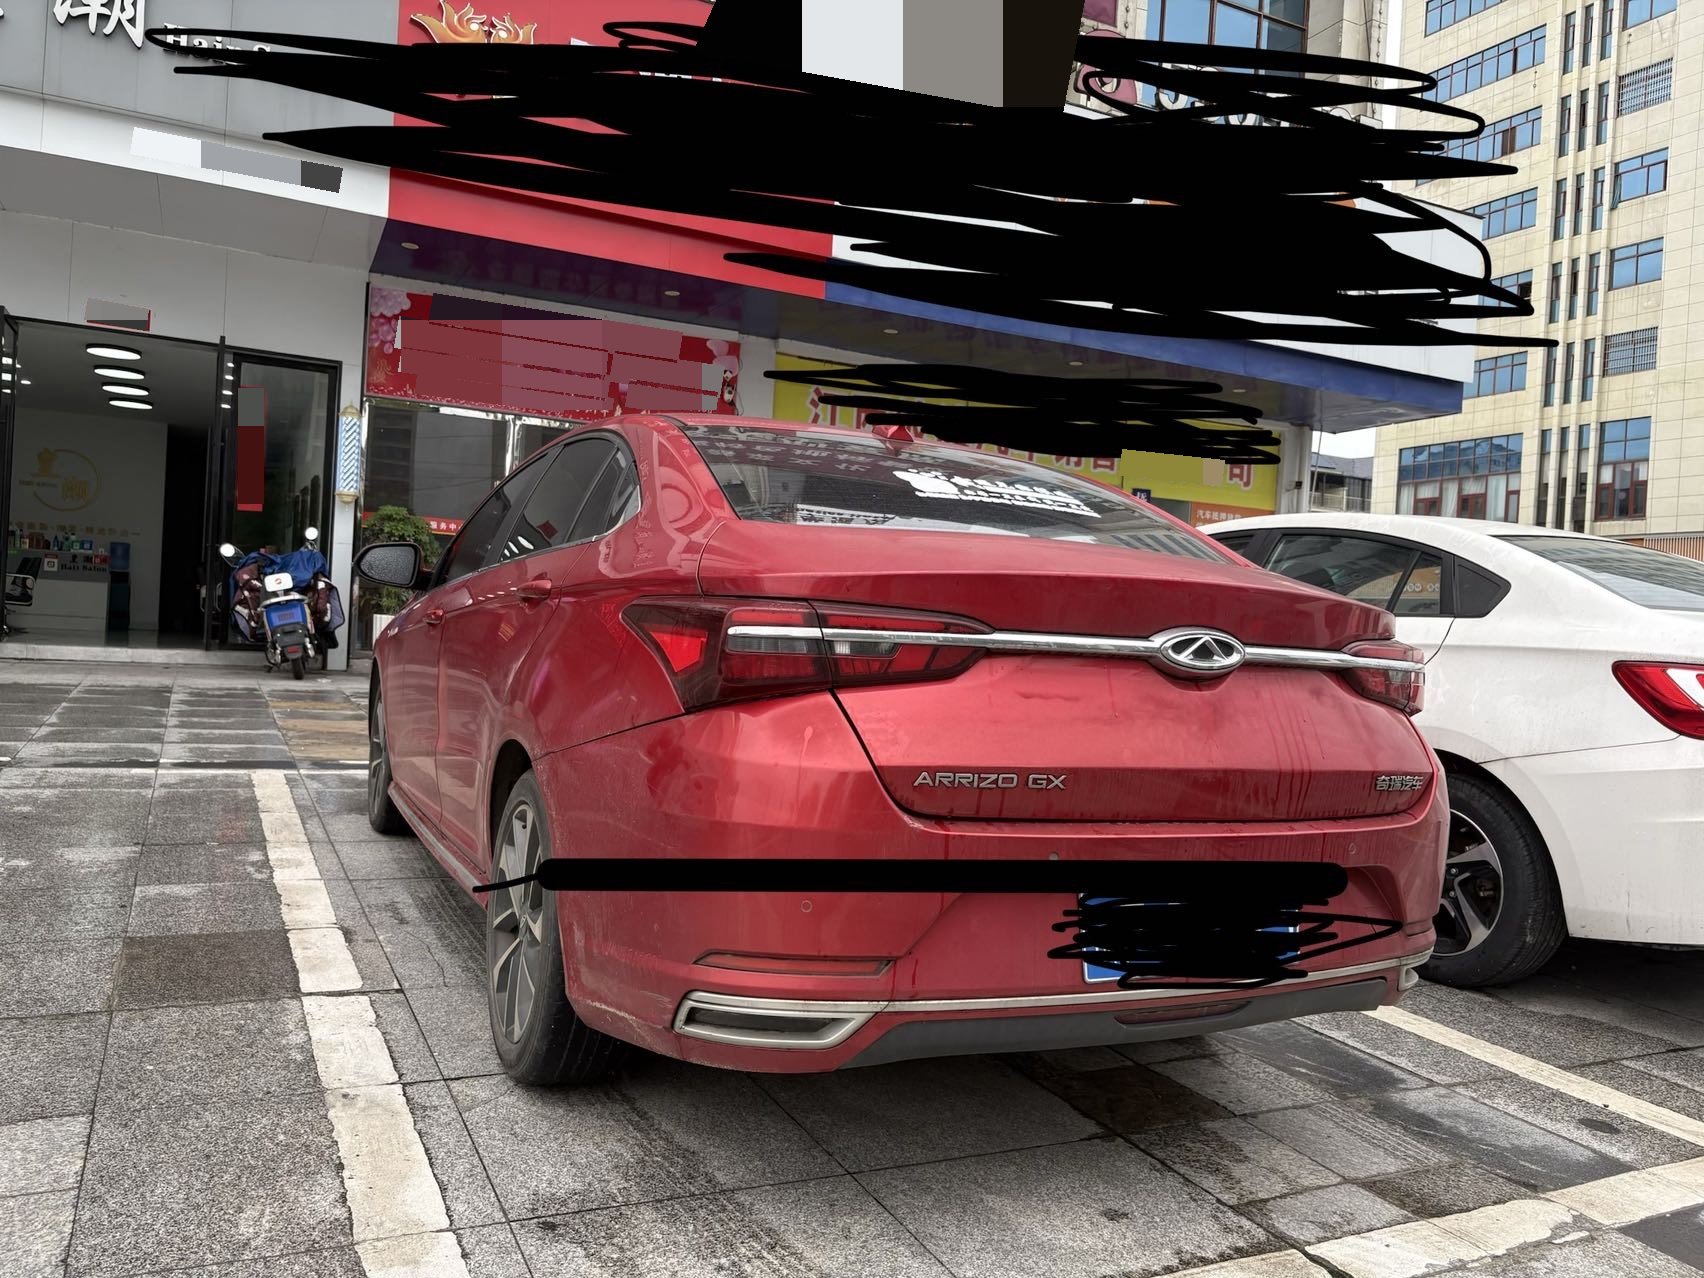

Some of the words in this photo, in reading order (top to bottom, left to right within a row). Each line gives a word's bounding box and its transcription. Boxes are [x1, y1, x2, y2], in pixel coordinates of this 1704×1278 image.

[912, 771, 1018, 788] ARRIZO
[1028, 773, 1068, 789] GX
[1375, 775, 1424, 791] 奇瑞汽车
